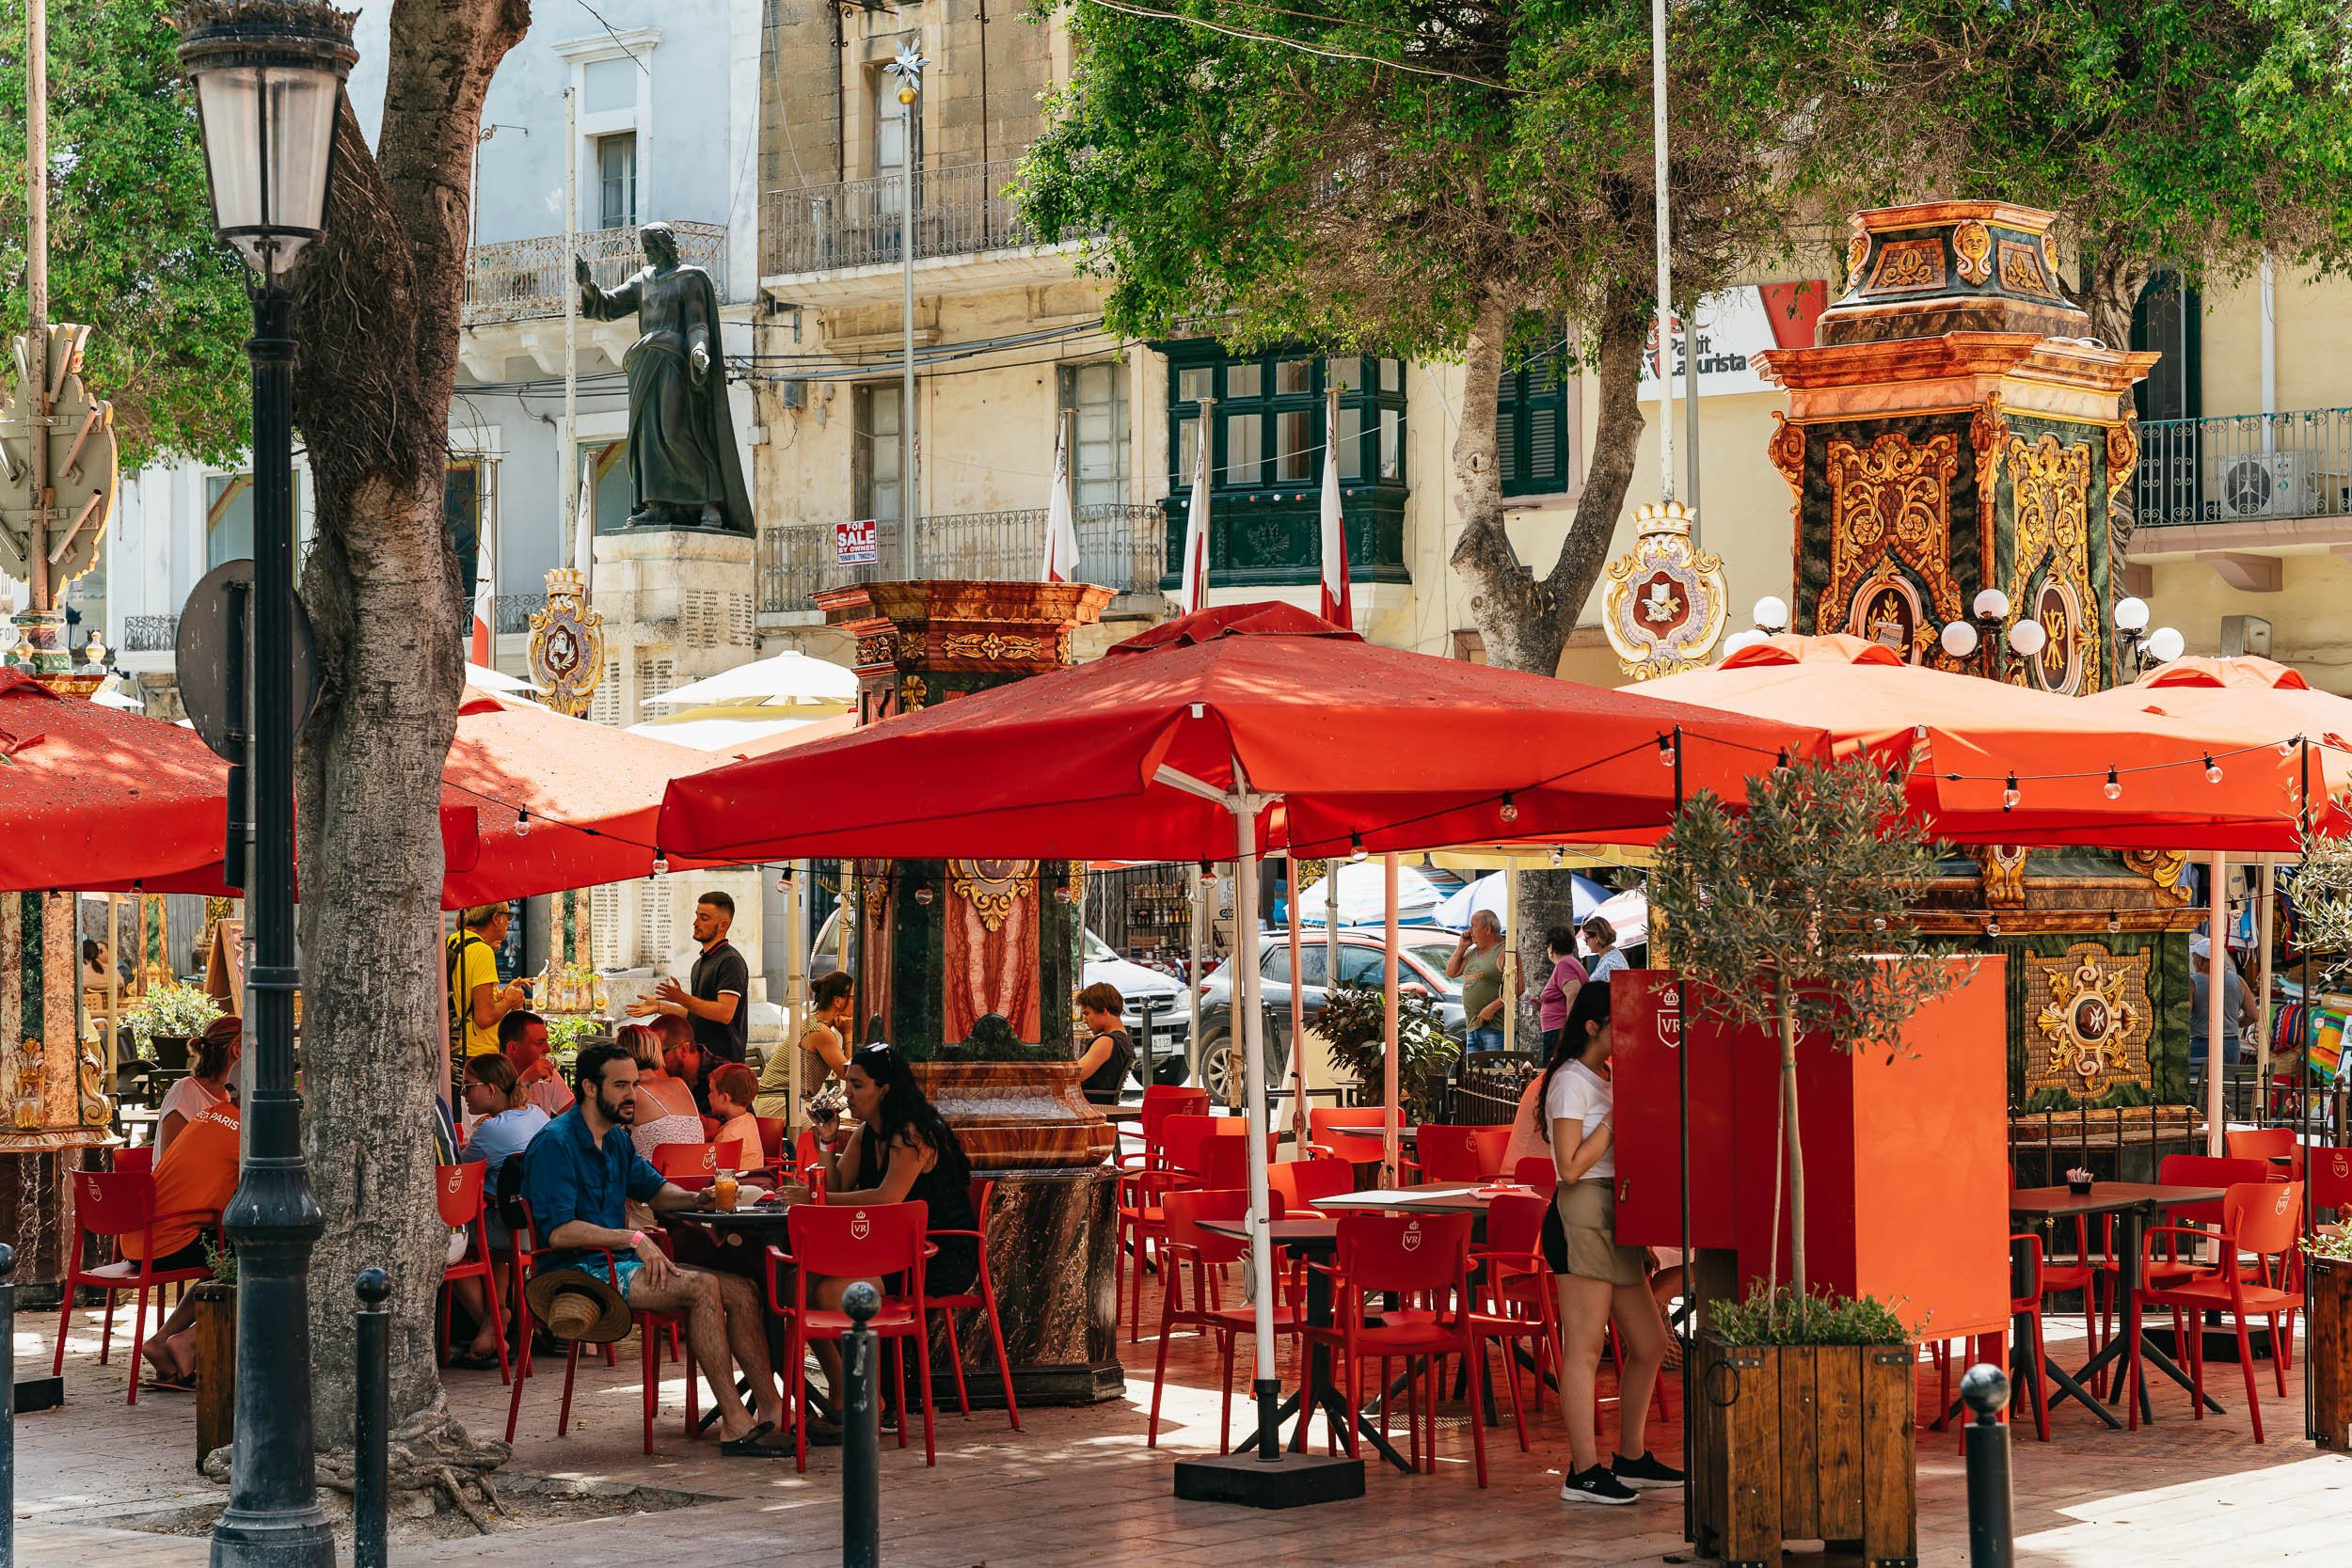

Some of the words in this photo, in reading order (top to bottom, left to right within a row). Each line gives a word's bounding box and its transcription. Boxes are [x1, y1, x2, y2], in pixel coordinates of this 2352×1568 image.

[1671, 335, 1711, 356] Patit
[1671, 353, 1746, 376] aurista
[847, 522, 865, 531] FOR
[838, 530, 875, 547] SALE
[1661, 1019, 1679, 1033] VR
[209, 1112, 240, 1131] PARIS
[854, 1224, 866, 1232] VR
[1406, 1236, 1418, 1244] VR
